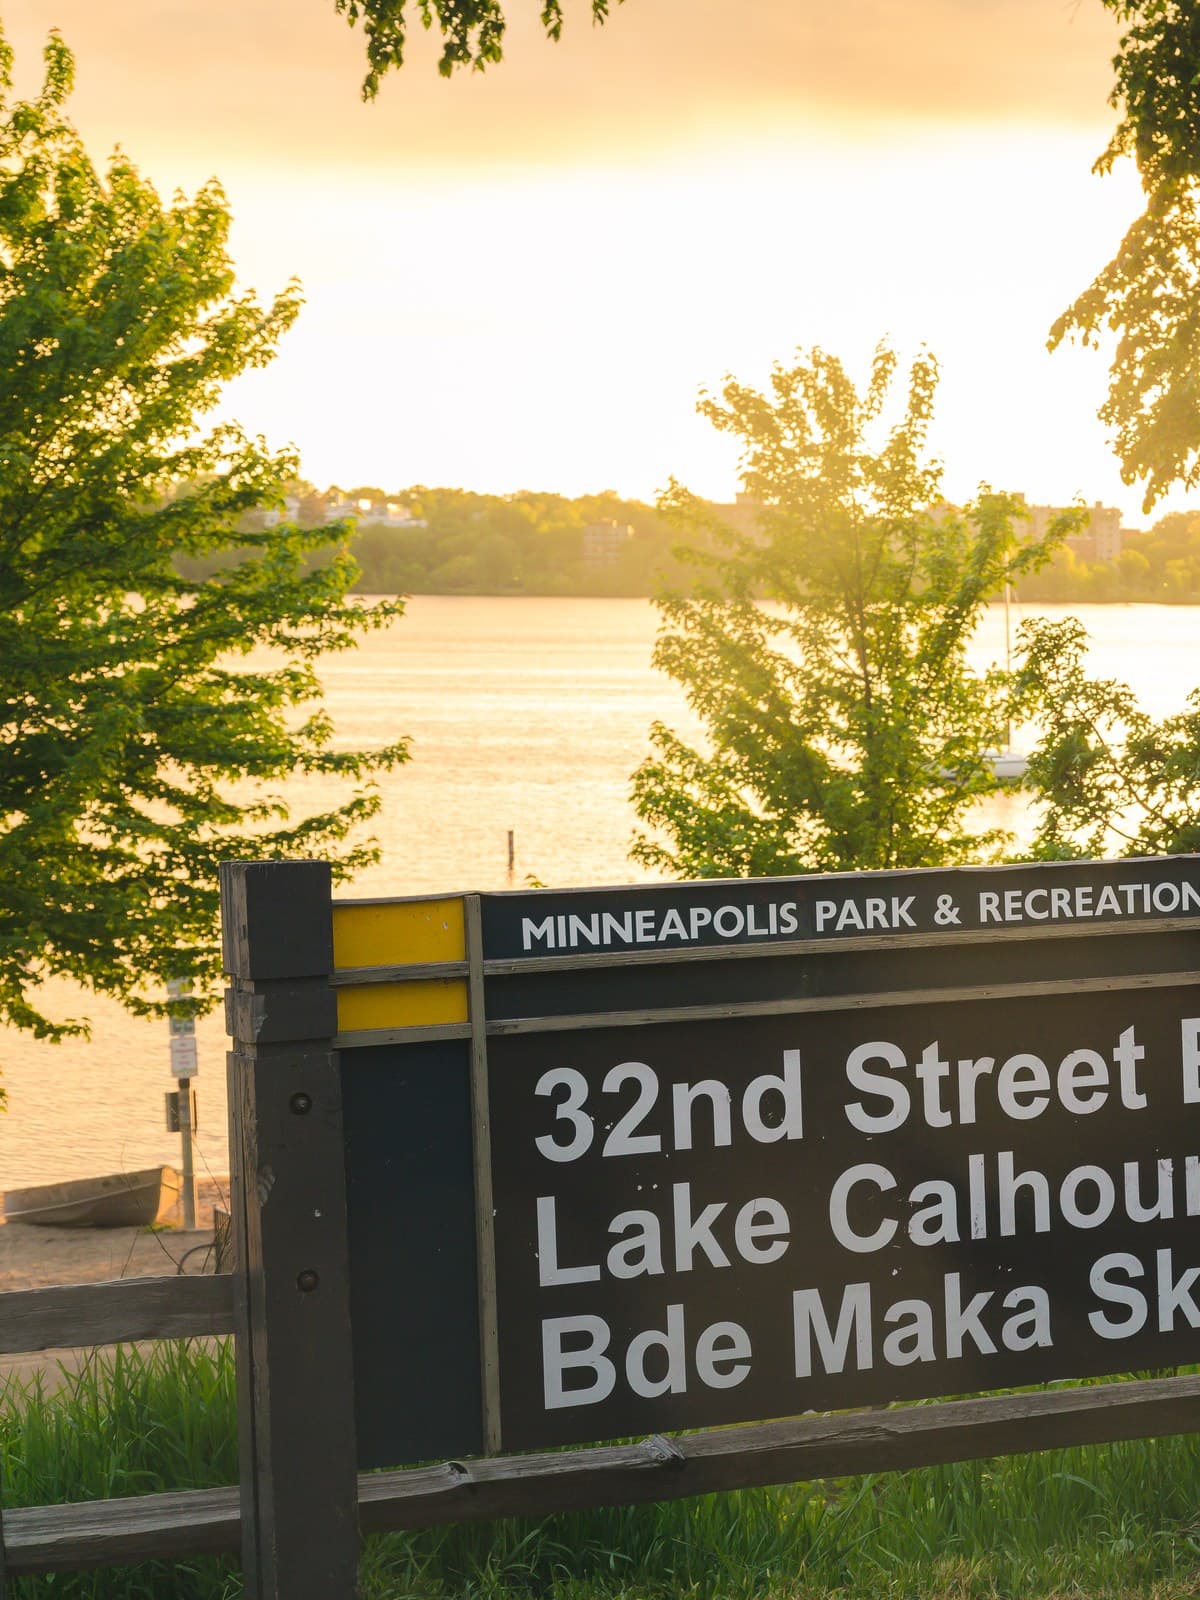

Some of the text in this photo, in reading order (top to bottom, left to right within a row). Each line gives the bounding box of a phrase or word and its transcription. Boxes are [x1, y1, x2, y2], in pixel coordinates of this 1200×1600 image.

[522, 902, 798, 951] MINNEAPOLIS
[815, 896, 917, 932] PARK
[933, 894, 962, 926] &
[534, 1048, 803, 1163] 32nd
[844, 1024, 1148, 1134] Street
[536, 1182, 791, 1287] Lake
[541, 1303, 752, 1410] Bde
[792, 1271, 1054, 1378] Maka
